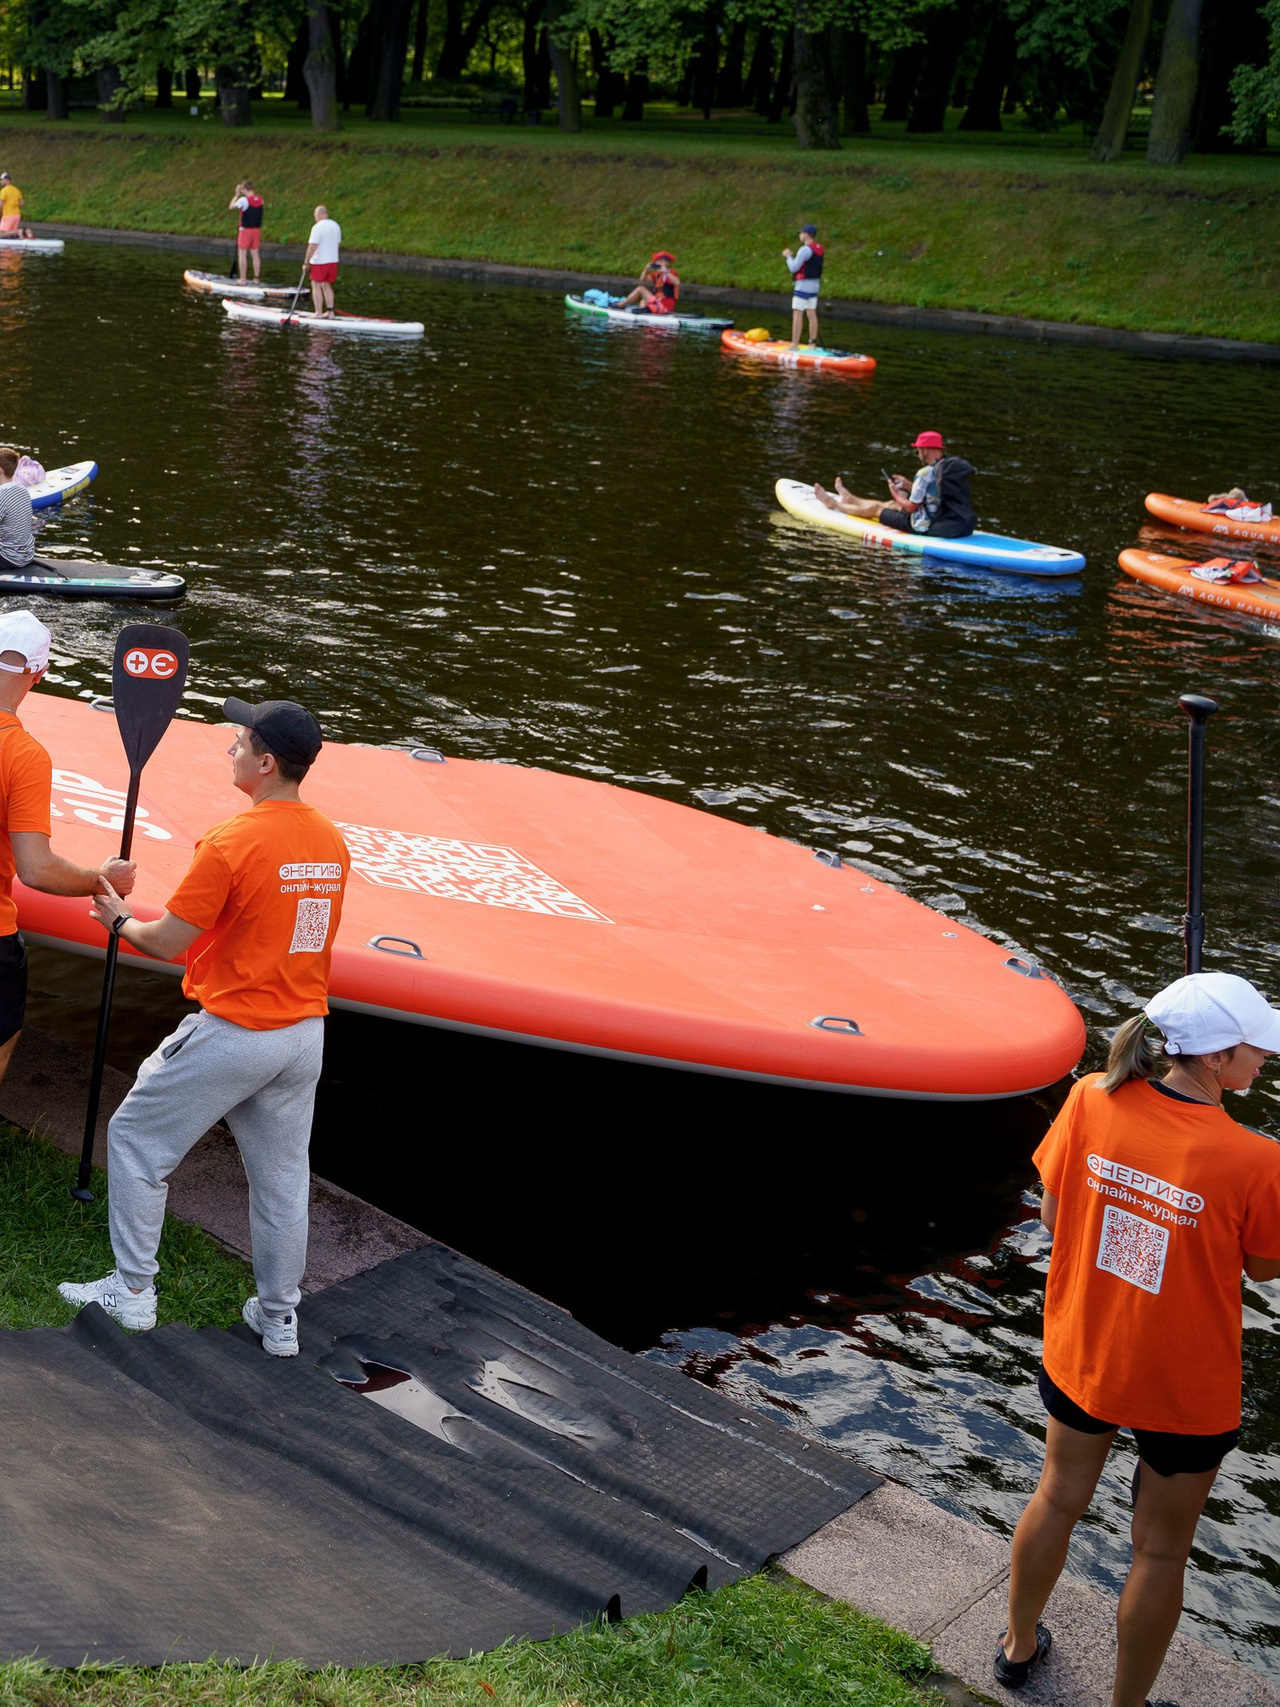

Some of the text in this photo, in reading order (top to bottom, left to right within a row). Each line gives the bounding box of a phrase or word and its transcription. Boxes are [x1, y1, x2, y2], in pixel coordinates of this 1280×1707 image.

[1233, 529, 1265, 540] AQUA
[1199, 592, 1231, 607] AQUA
[1236, 602, 1280, 620] MARIN
[280, 880, 341, 895] онлайн-журнал
[1086, 1177, 1198, 1229] онлайн-журнал
